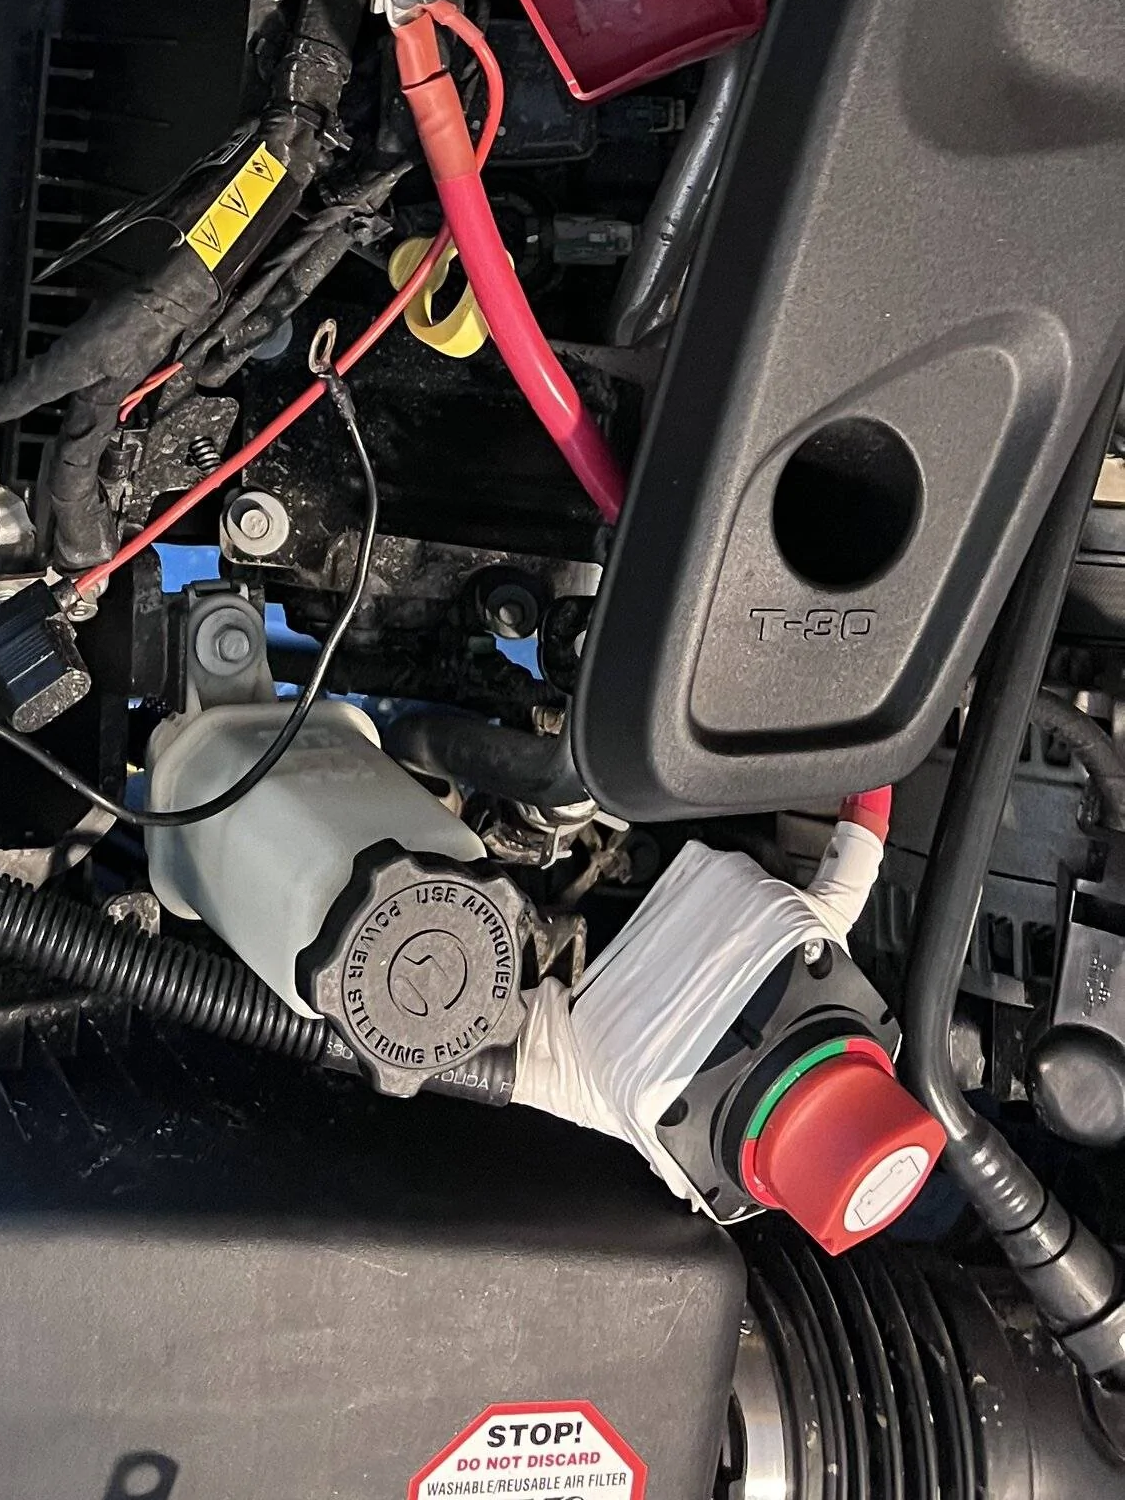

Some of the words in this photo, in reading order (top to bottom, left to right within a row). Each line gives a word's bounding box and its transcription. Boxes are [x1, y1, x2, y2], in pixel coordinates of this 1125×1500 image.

[416, 886, 458, 904] USE
[462, 895, 511, 1000] APPROVED
[434, 1016, 490, 1062] FLUID
[487, 1421, 583, 1448] STOP!
[457, 1458, 481, 1471] DO
[486, 1456, 522, 1470] NOT
[527, 1451, 601, 1468] DISCARD
[427, 1477, 560, 1496] WASHABLE/REUSABLE
[564, 1474, 584, 1488] AIR
[588, 1472, 627, 1488] FILTER
